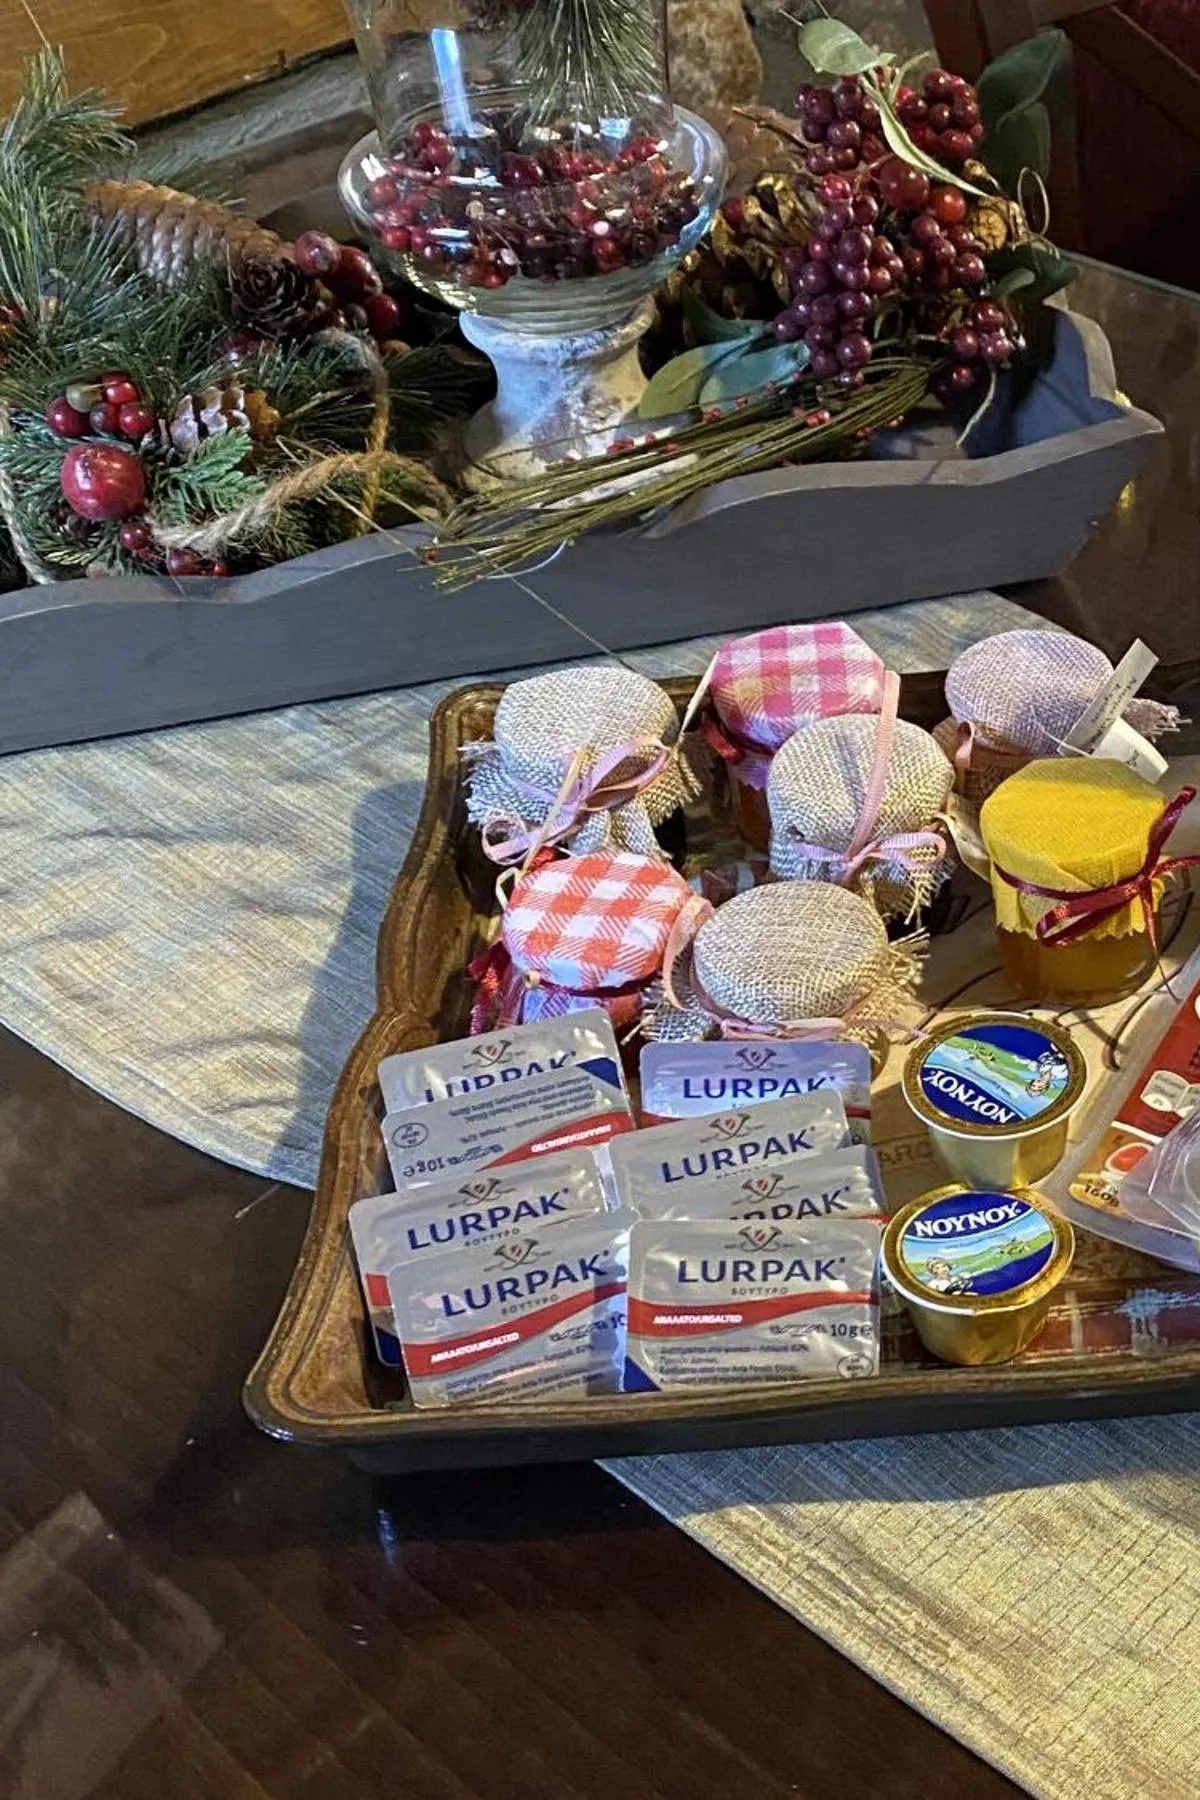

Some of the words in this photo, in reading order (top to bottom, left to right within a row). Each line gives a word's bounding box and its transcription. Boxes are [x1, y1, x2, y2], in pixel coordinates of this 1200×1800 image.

[682, 1077, 826, 1099] LURPAK
[661, 1129, 815, 1183] LURPAK
[407, 1192, 567, 1250] LURPAK
[914, 1201, 1019, 1236] NOYNOY
[442, 1257, 607, 1317] LURPAK
[678, 1258, 840, 1283] LURPAK
